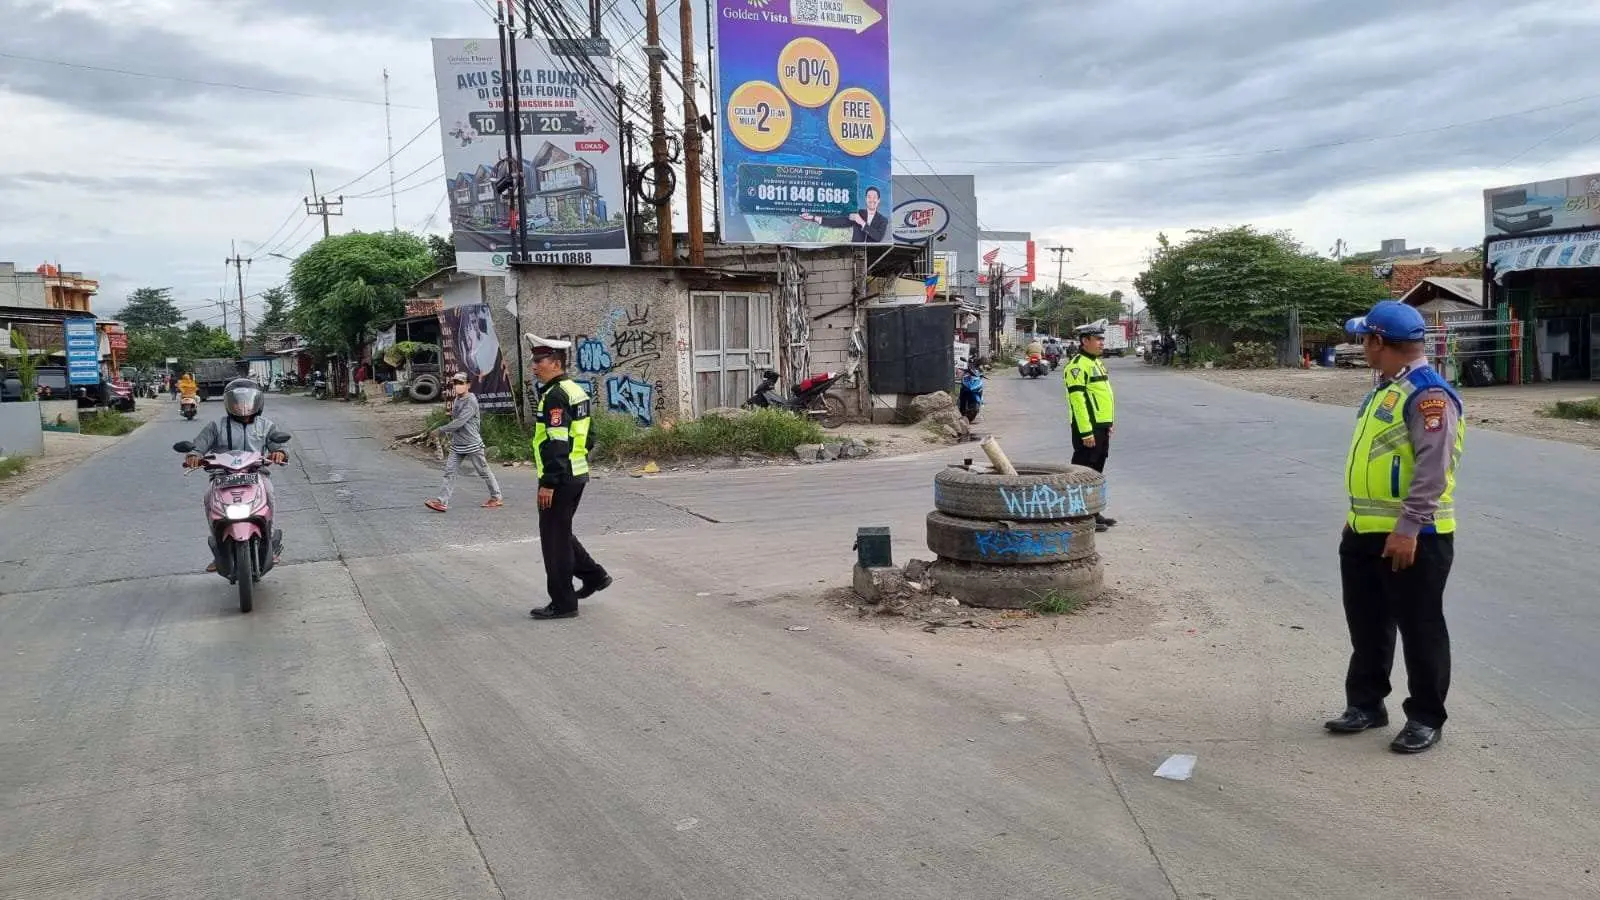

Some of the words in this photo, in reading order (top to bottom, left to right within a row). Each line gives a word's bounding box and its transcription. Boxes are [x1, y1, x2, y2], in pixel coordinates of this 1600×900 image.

[821, 1, 843, 12] LOKASI
[723, 8, 759, 21] Golden
[761, 11, 789, 24] Vista
[826, 13, 863, 25] KILOMETER
[798, 57, 830, 86] 0%
[457, 72, 488, 90] AKU
[537, 69, 590, 88] RUMAH
[478, 88, 490, 99] DI
[492, 86, 533, 97] GOEN
[536, 86, 578, 98] FLOWER
[517, 100, 553, 108] ANGSUNG
[843, 101, 870, 119] FREE
[540, 117, 562, 132] 20
[757, 102, 770, 132] 2
[477, 118, 496, 133] 10
[841, 122, 874, 140] BIAYA
[758, 184, 788, 201] 0811
[790, 185, 815, 202] 848
[817, 187, 850, 204] 6688
[911, 208, 935, 221] PLANET
[917, 218, 930, 227] BAN
[506, 253, 533, 265] 01
[535, 253, 560, 264] 9711
[562, 251, 592, 264] 0888
